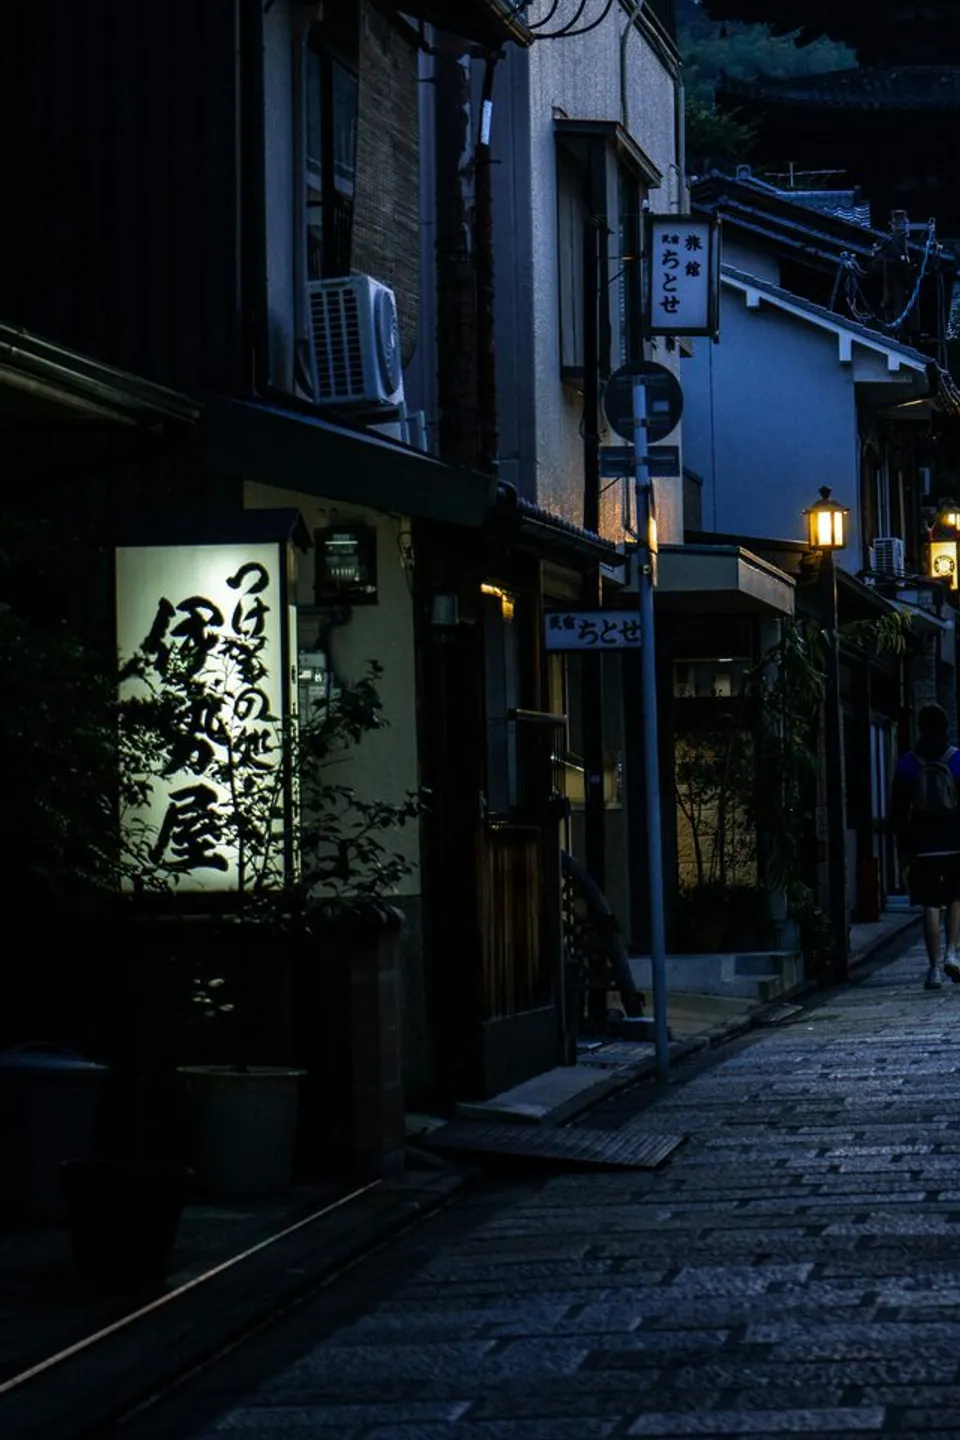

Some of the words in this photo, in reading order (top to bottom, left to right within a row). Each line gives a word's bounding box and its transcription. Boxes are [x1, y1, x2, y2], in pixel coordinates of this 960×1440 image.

[685, 235, 702, 277] 旅館
[661, 249, 680, 313] ちとせ
[578, 619, 641, 645] ちとせ
